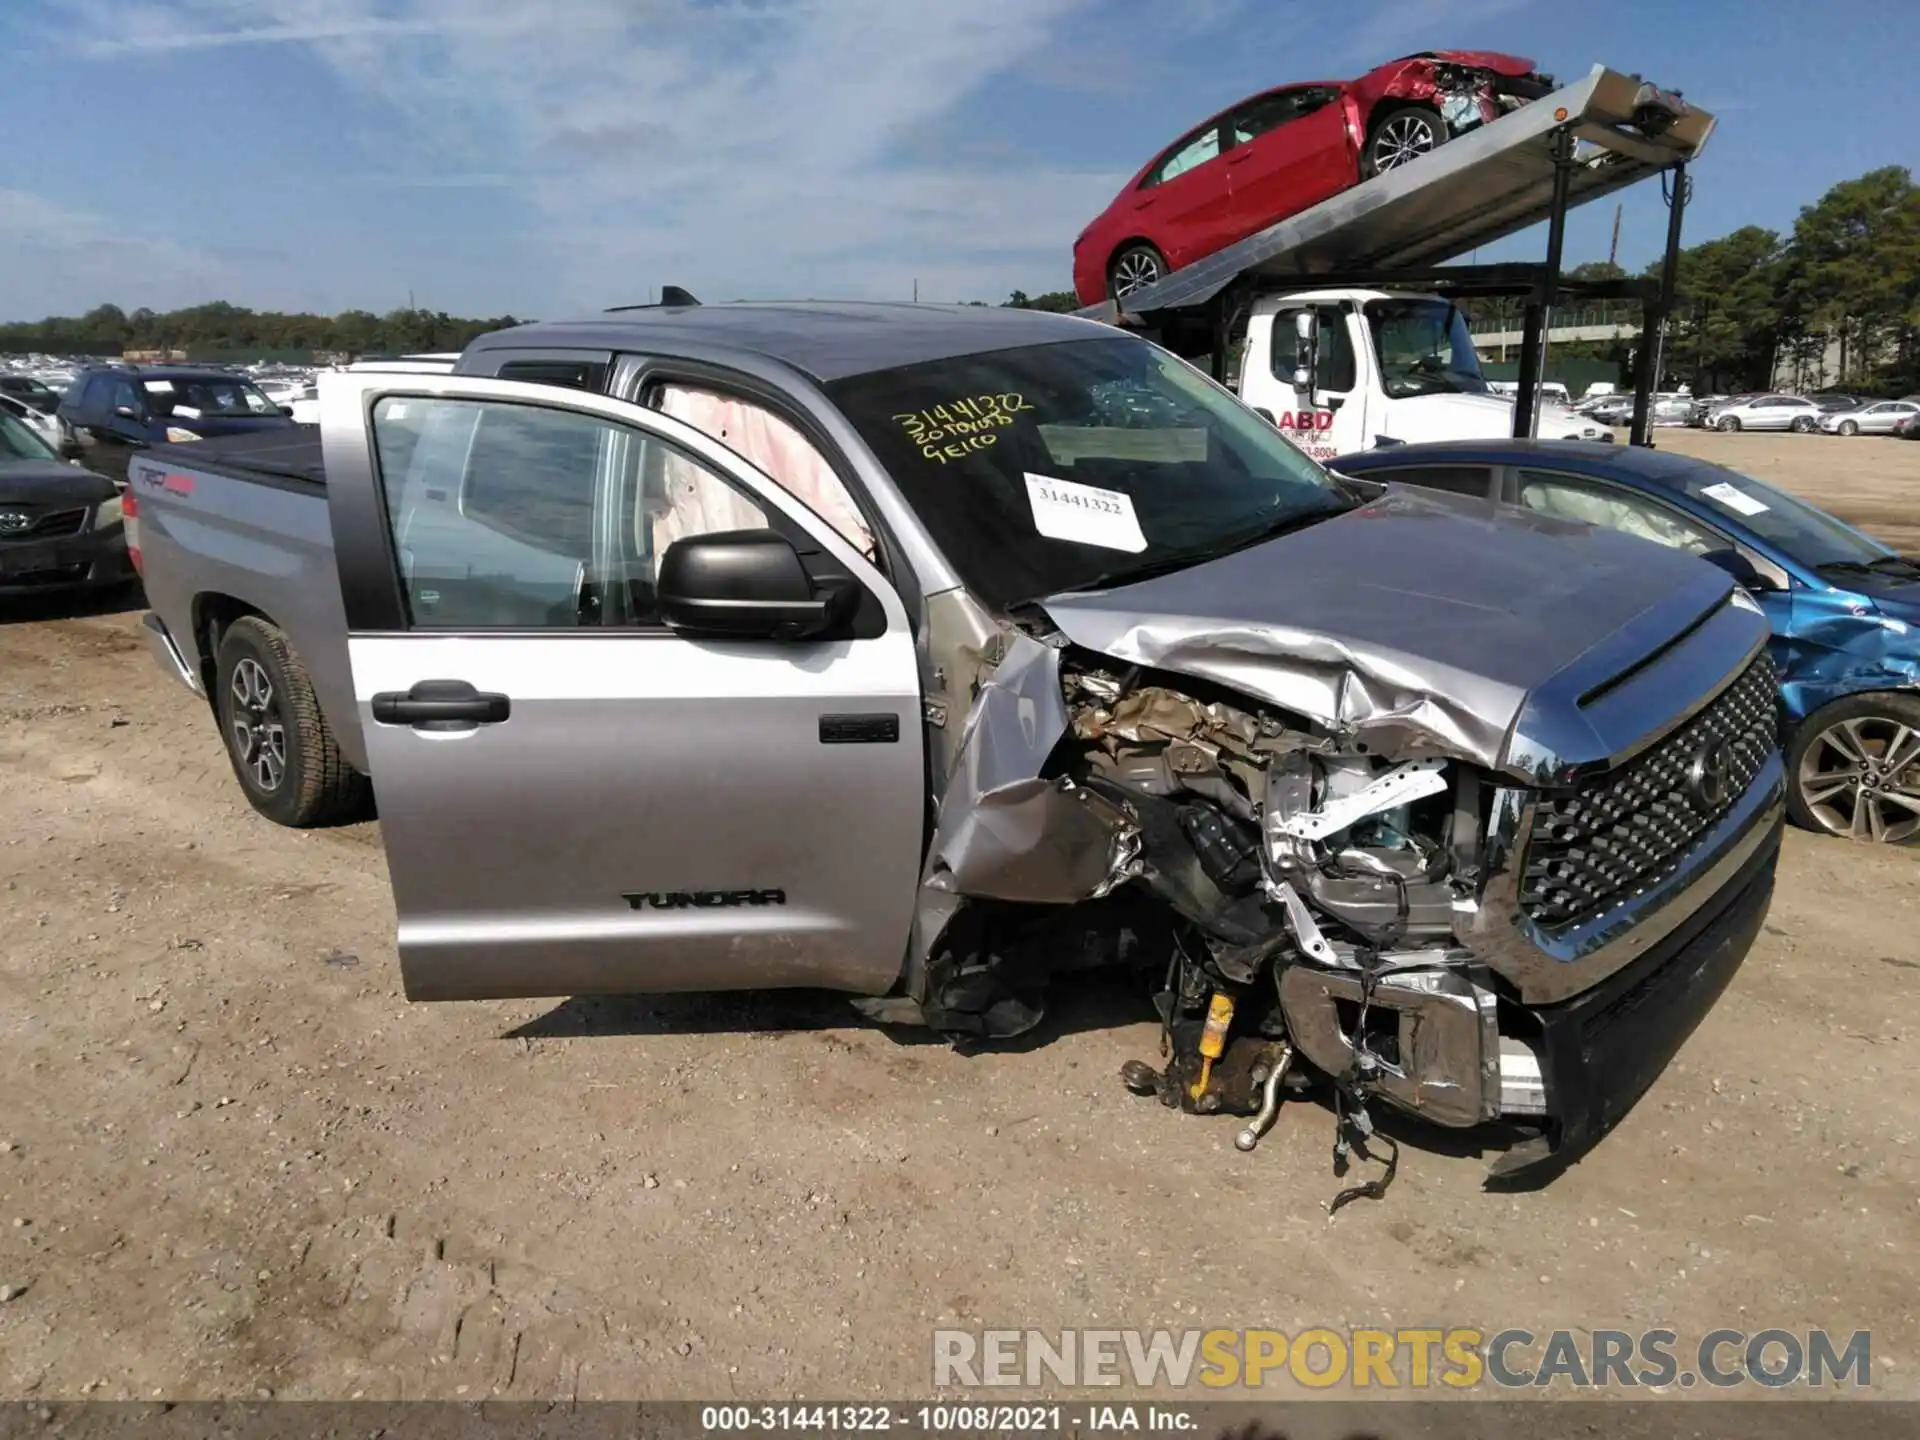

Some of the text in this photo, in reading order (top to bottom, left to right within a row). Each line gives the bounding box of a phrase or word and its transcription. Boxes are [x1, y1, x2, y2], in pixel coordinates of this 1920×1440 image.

[1279, 411, 1333, 430] ABD
[923, 434, 997, 464] GEICO
[1039, 487, 1122, 515] 31441322
[621, 889, 787, 910] TUNDRA
